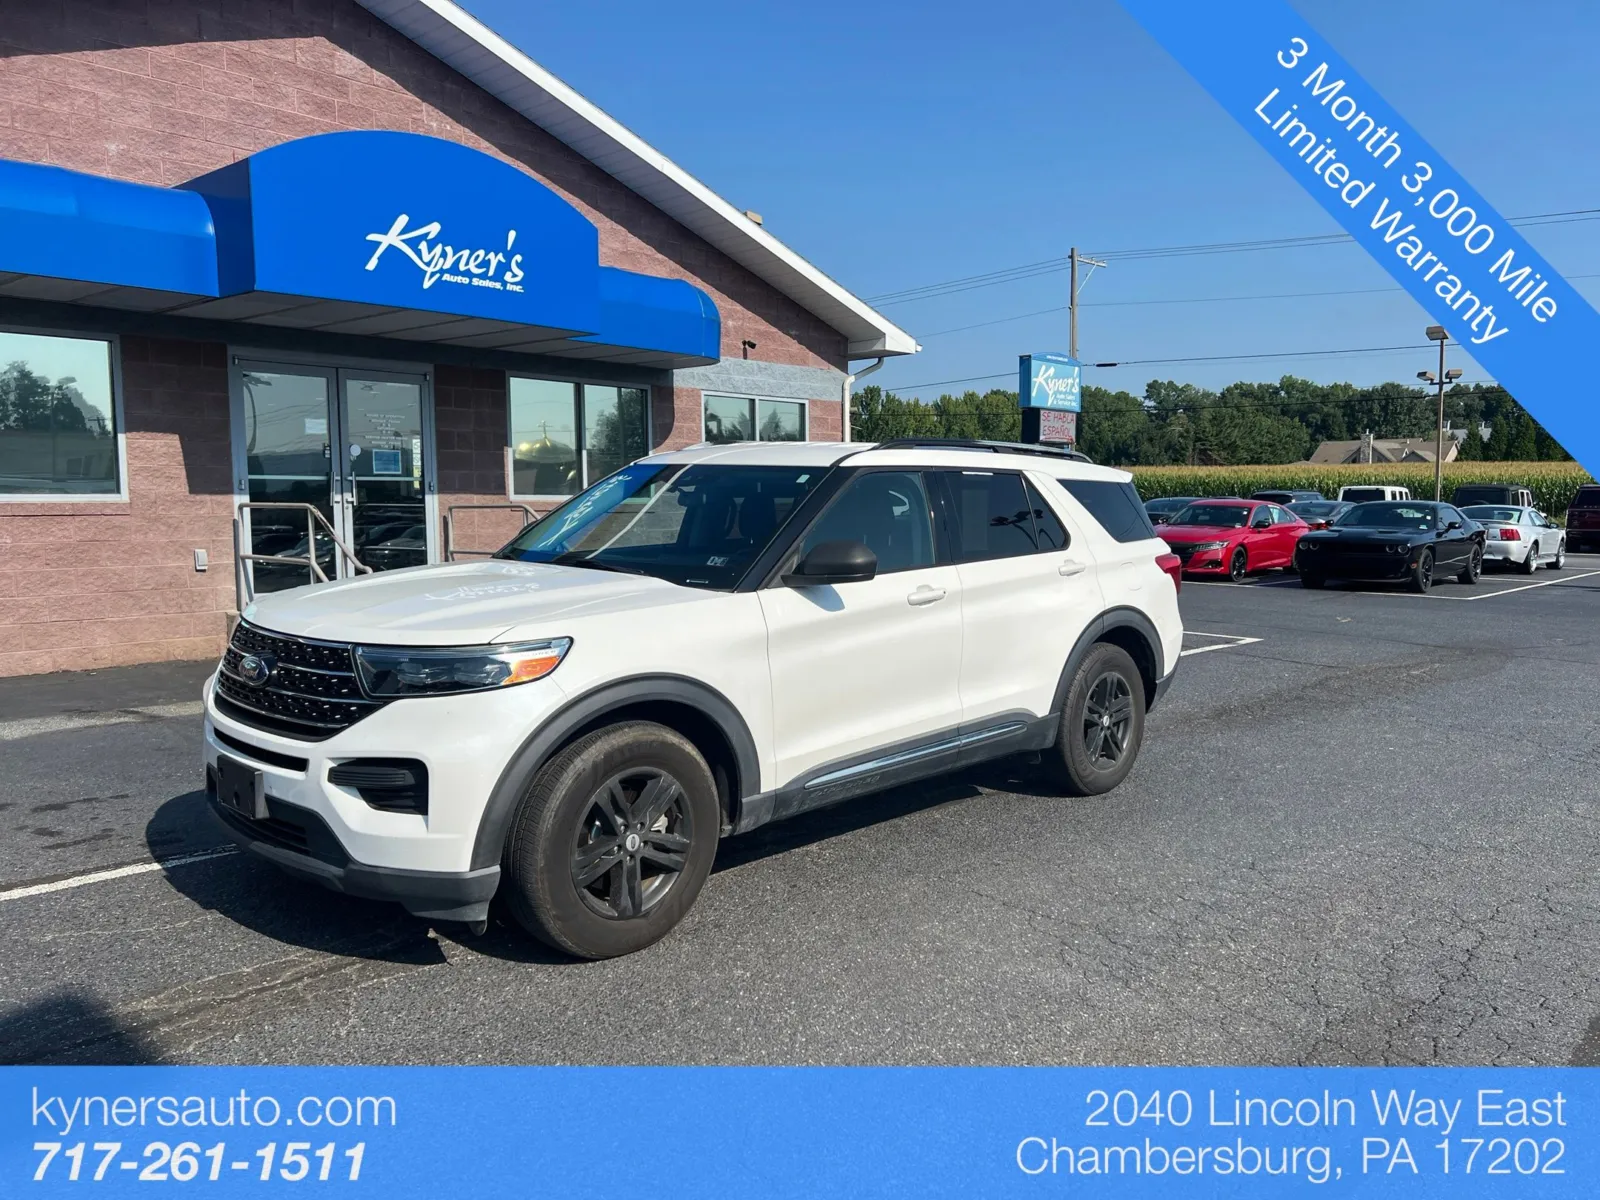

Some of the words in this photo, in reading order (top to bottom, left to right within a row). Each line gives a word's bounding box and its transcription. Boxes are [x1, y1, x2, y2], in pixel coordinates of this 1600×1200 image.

[365, 213, 524, 289] Kyner's
[441, 273, 470, 284] Auto
[471, 277, 503, 290] Sales,
[506, 283, 524, 293] Inc.
[1032, 364, 1079, 407] Kyner's
[1042, 411, 1052, 422] SE
[1054, 412, 1075, 424] HABLA
[1043, 425, 1073, 438] ESPAÑOL
